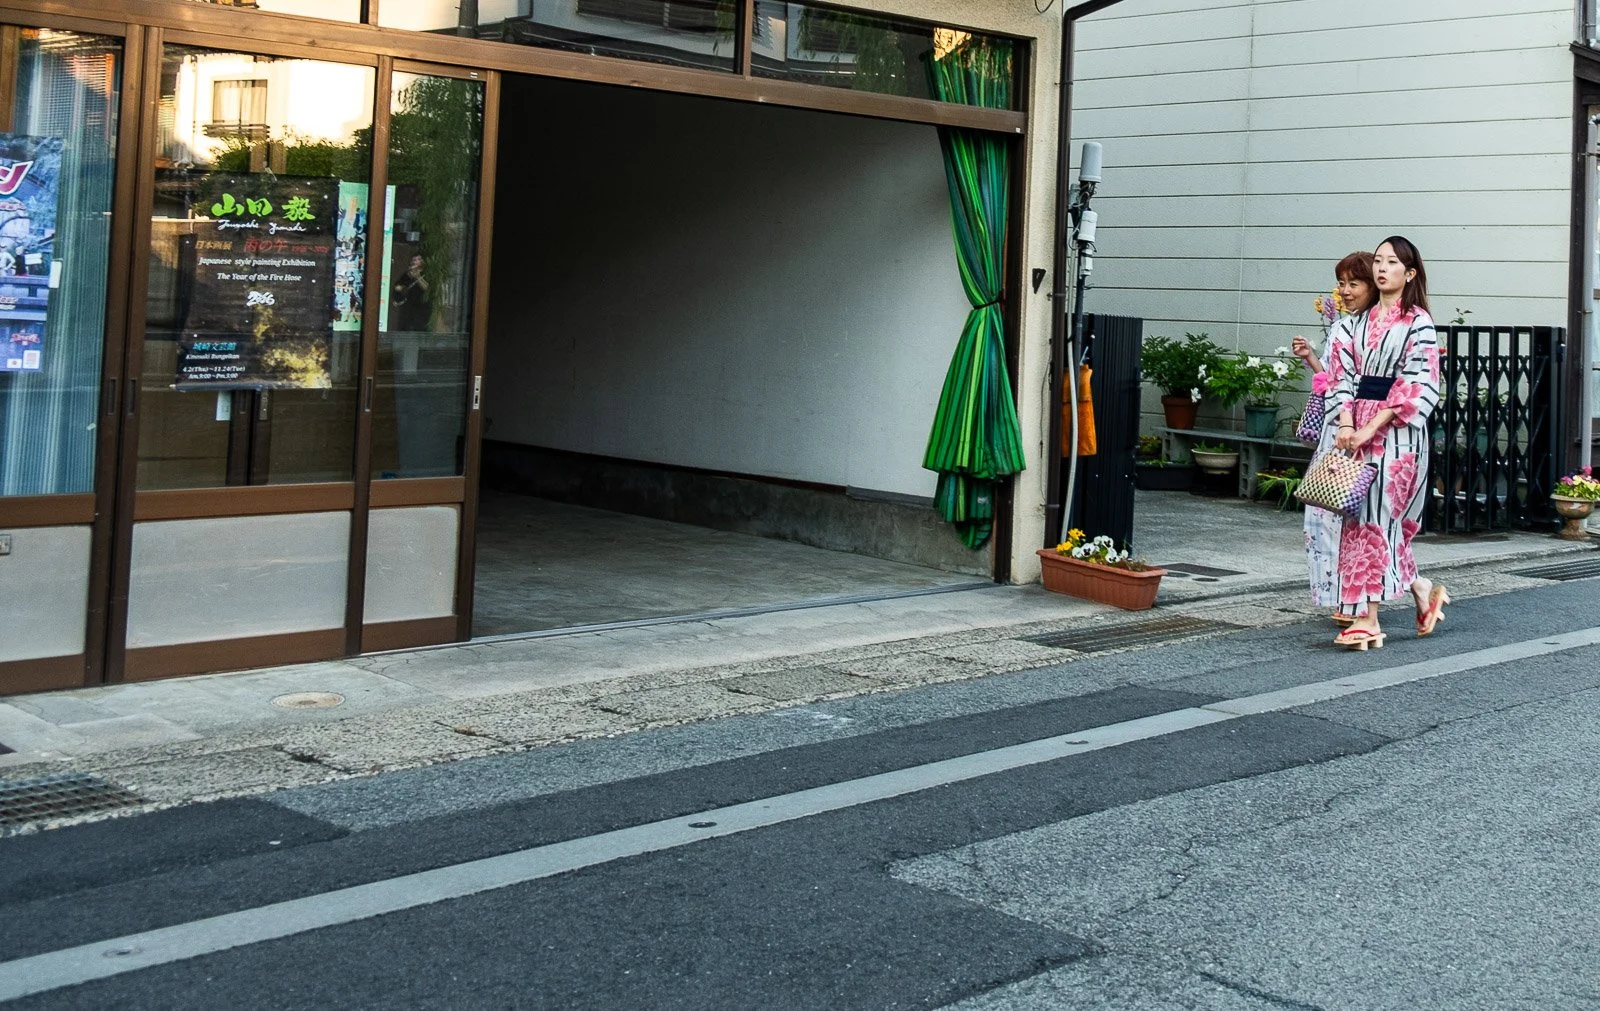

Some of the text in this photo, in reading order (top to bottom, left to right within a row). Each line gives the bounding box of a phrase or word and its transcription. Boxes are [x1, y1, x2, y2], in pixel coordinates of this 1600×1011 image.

[211, 193, 273, 216] 山田
[198, 257, 316, 267] Japanese style painting Exhibition
[217, 272, 231, 280] The
[232, 273, 248, 281] Year
[249, 273, 257, 282] of
[257, 273, 269, 281] the
[269, 273, 284, 281] Fire
